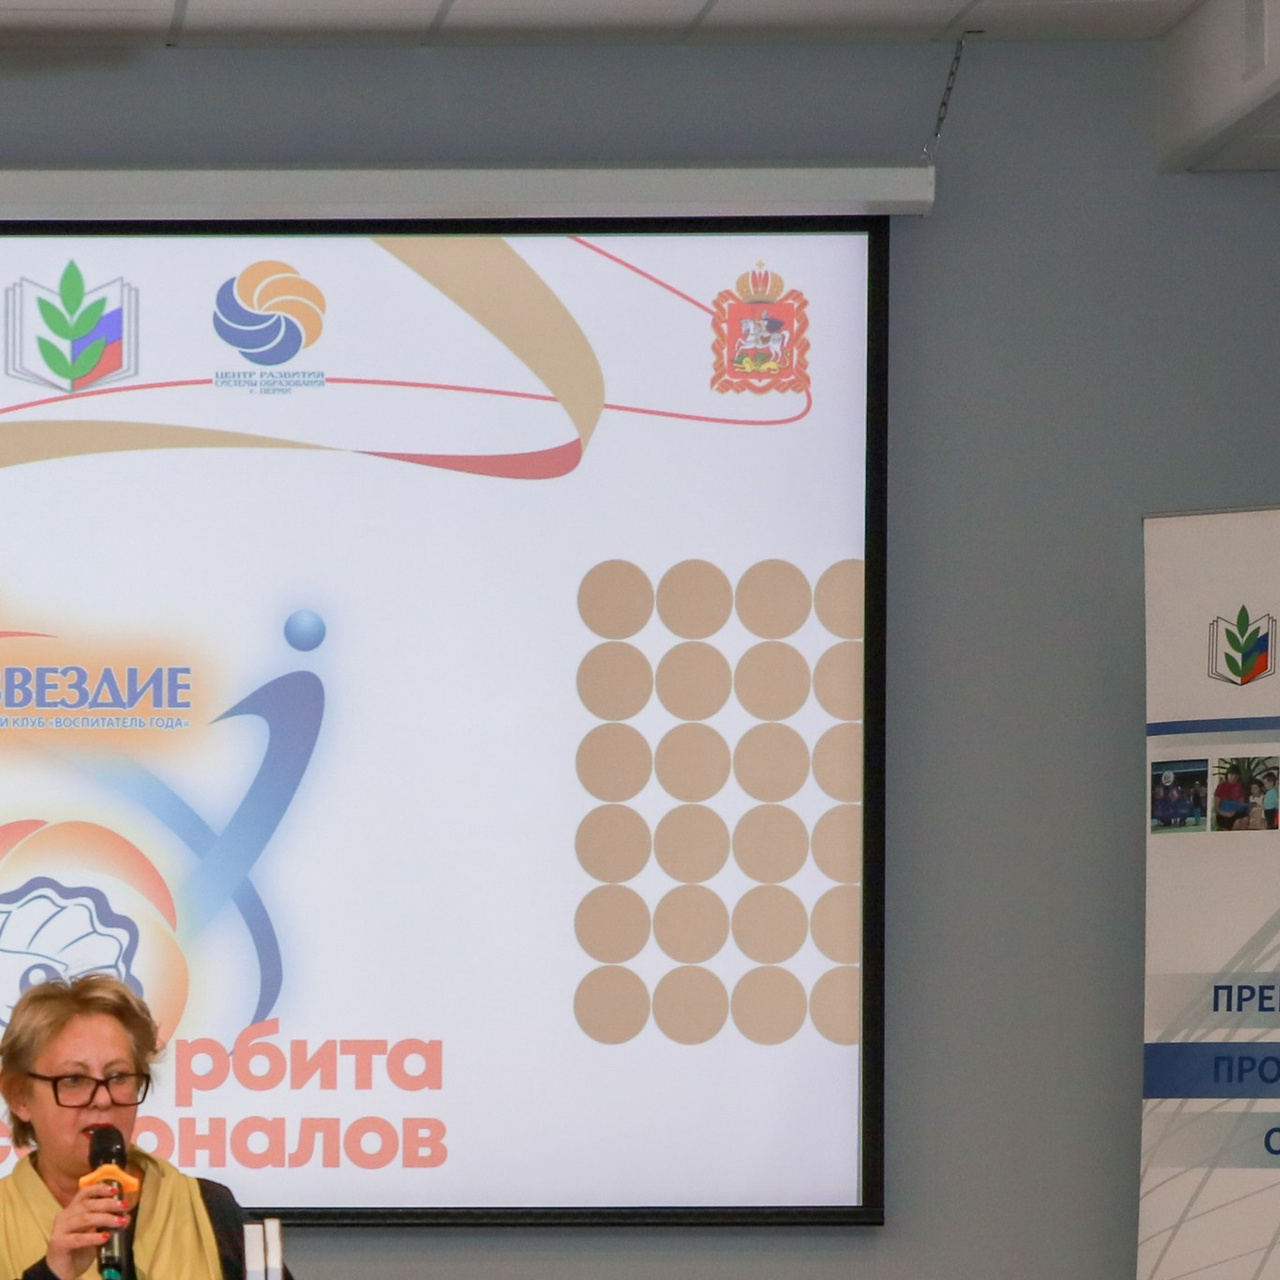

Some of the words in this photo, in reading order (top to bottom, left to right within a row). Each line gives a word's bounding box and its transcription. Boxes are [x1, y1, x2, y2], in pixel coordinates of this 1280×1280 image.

[215, 371, 256, 379] ЦЕНТР
[260, 371, 325, 379] РАЗВИТИЯ
[12, 716, 45, 728] КЛУБ
[49, 716, 146, 728] «ВОСПИТАТЕЛЬ
[149, 716, 189, 730] ГОДА»
[1213, 985, 1280, 1012] ПРЕ
[1213, 1056, 1280, 1084] ПРО
